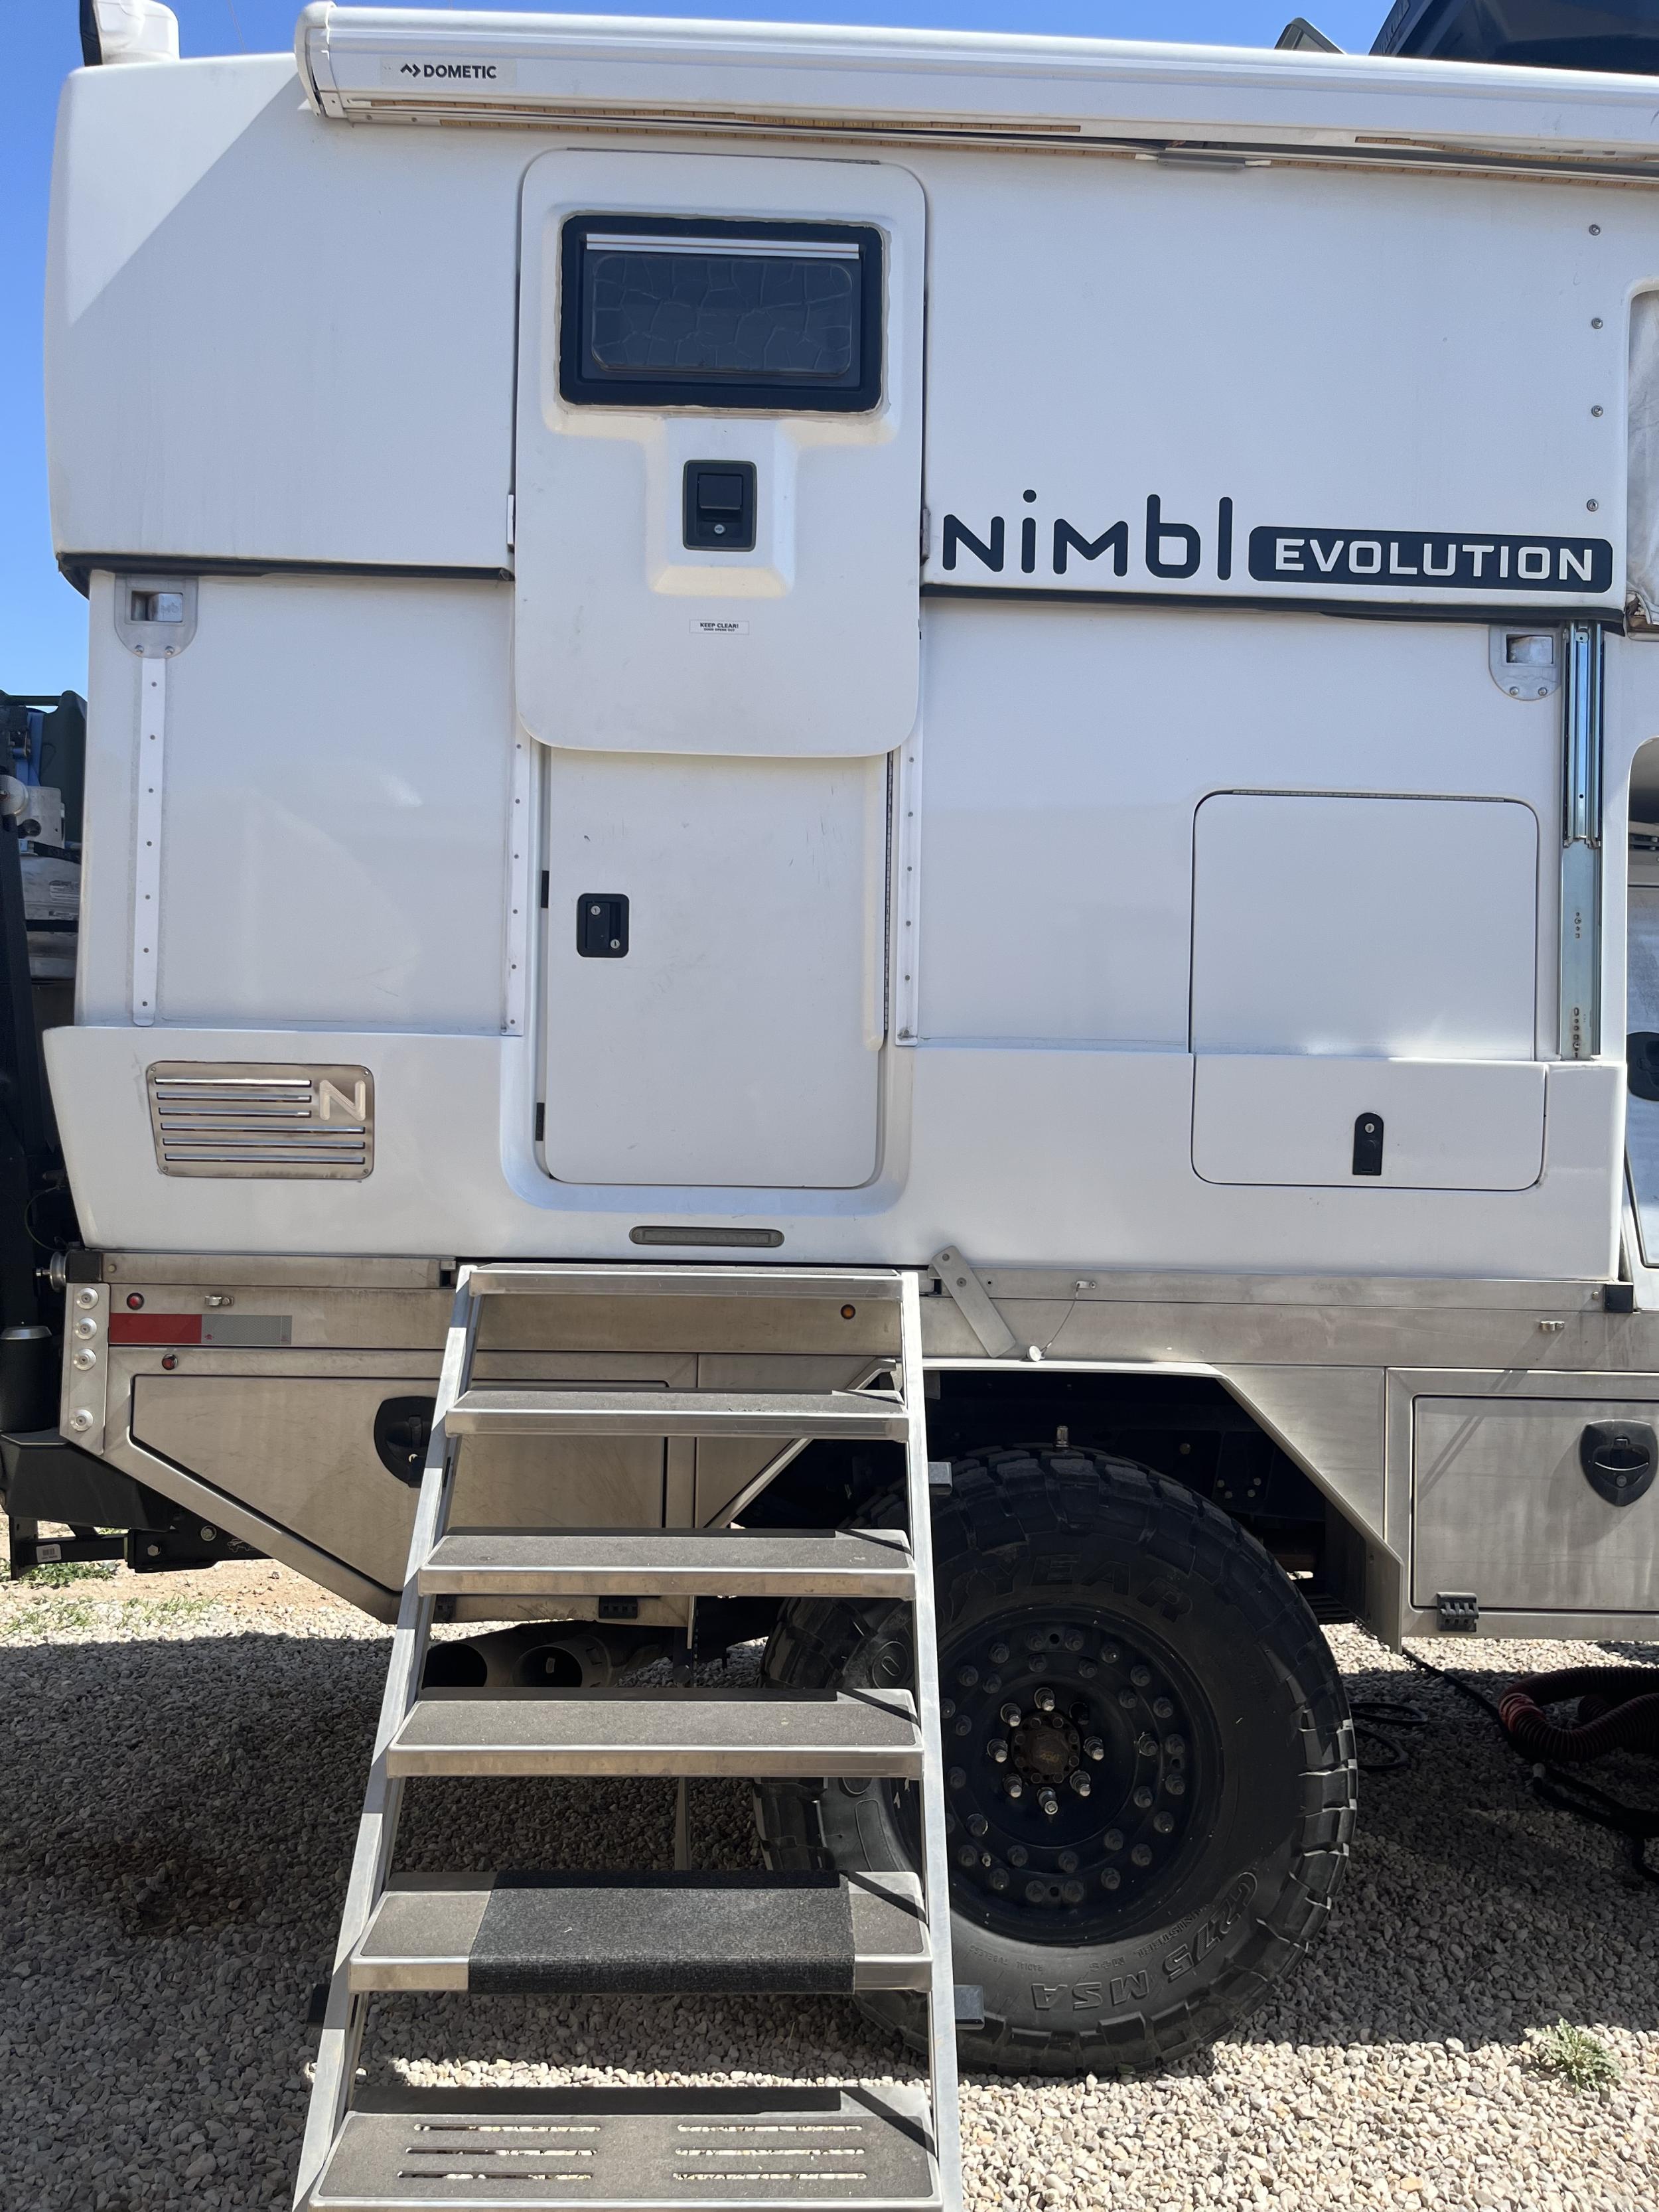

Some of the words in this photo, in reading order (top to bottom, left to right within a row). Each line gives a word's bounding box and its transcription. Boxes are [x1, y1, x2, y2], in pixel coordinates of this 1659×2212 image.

[423, 64, 497, 79] DOMETIC
[1275, 538, 1593, 581] EVOLUTION
[320, 1080, 365, 1121] N
[1162, 1872, 1258, 1984] G275
[968, 1945, 1008, 1966] TUBELESS
[1016, 1961, 1043, 1972] RADIAL
[1089, 1956, 1126, 1972] M+S
[1031, 1969, 1150, 2011] MSA
